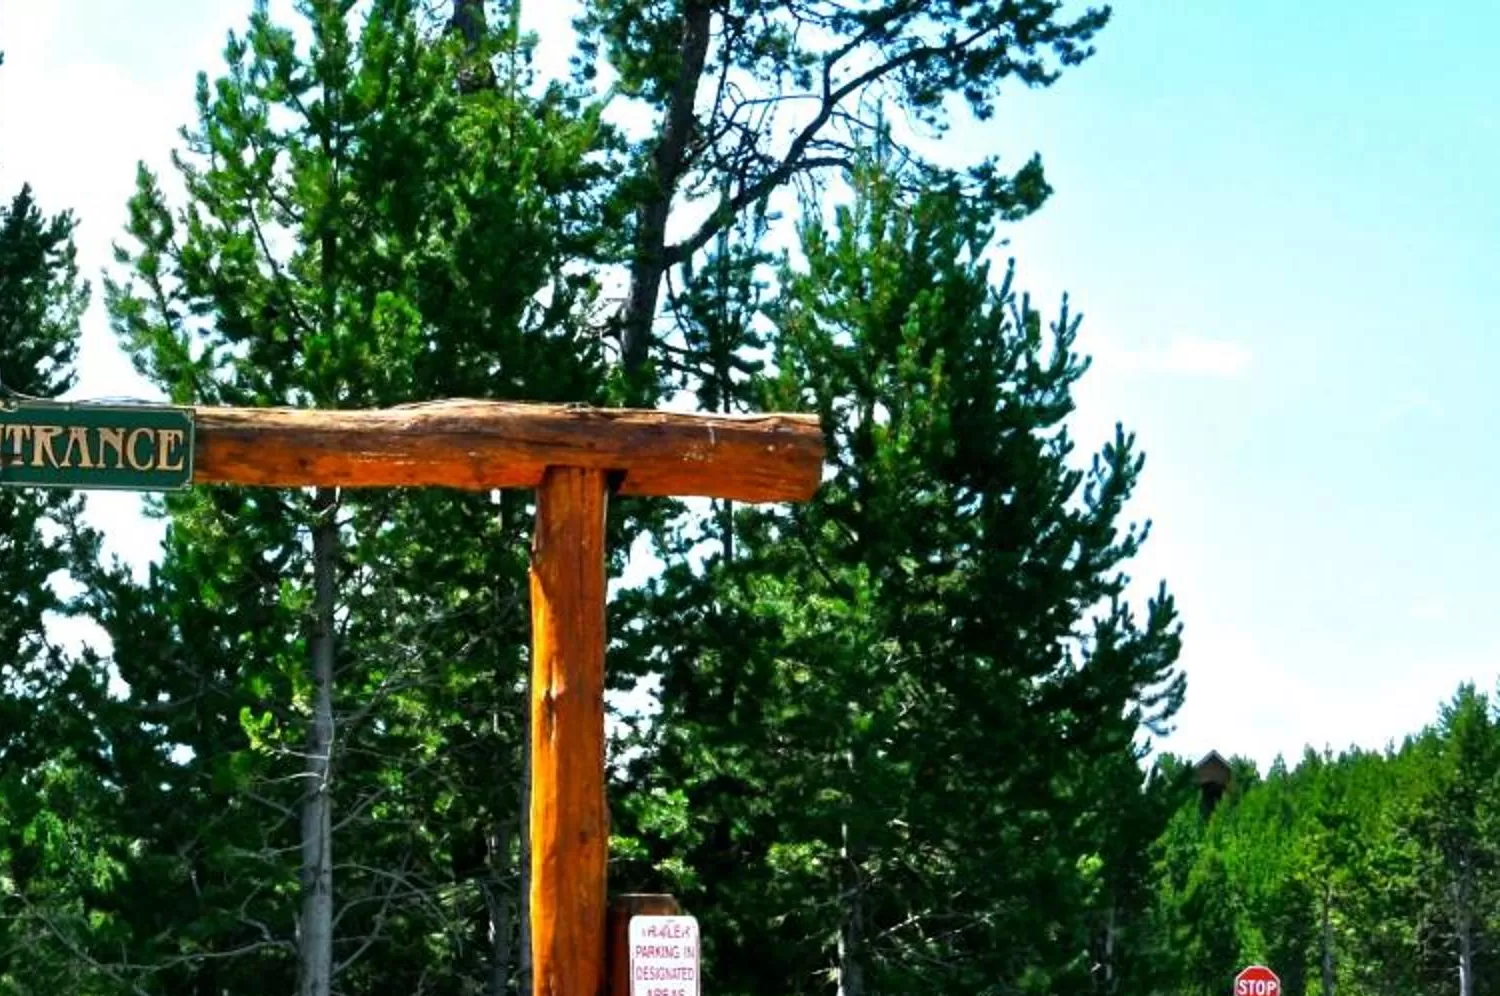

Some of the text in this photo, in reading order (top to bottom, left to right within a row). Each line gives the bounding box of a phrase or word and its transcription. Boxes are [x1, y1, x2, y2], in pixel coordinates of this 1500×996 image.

[635, 945, 695, 959] PARKING IN
[636, 966, 695, 981] DESIGNATED
[1236, 979, 1277, 996] STOP
